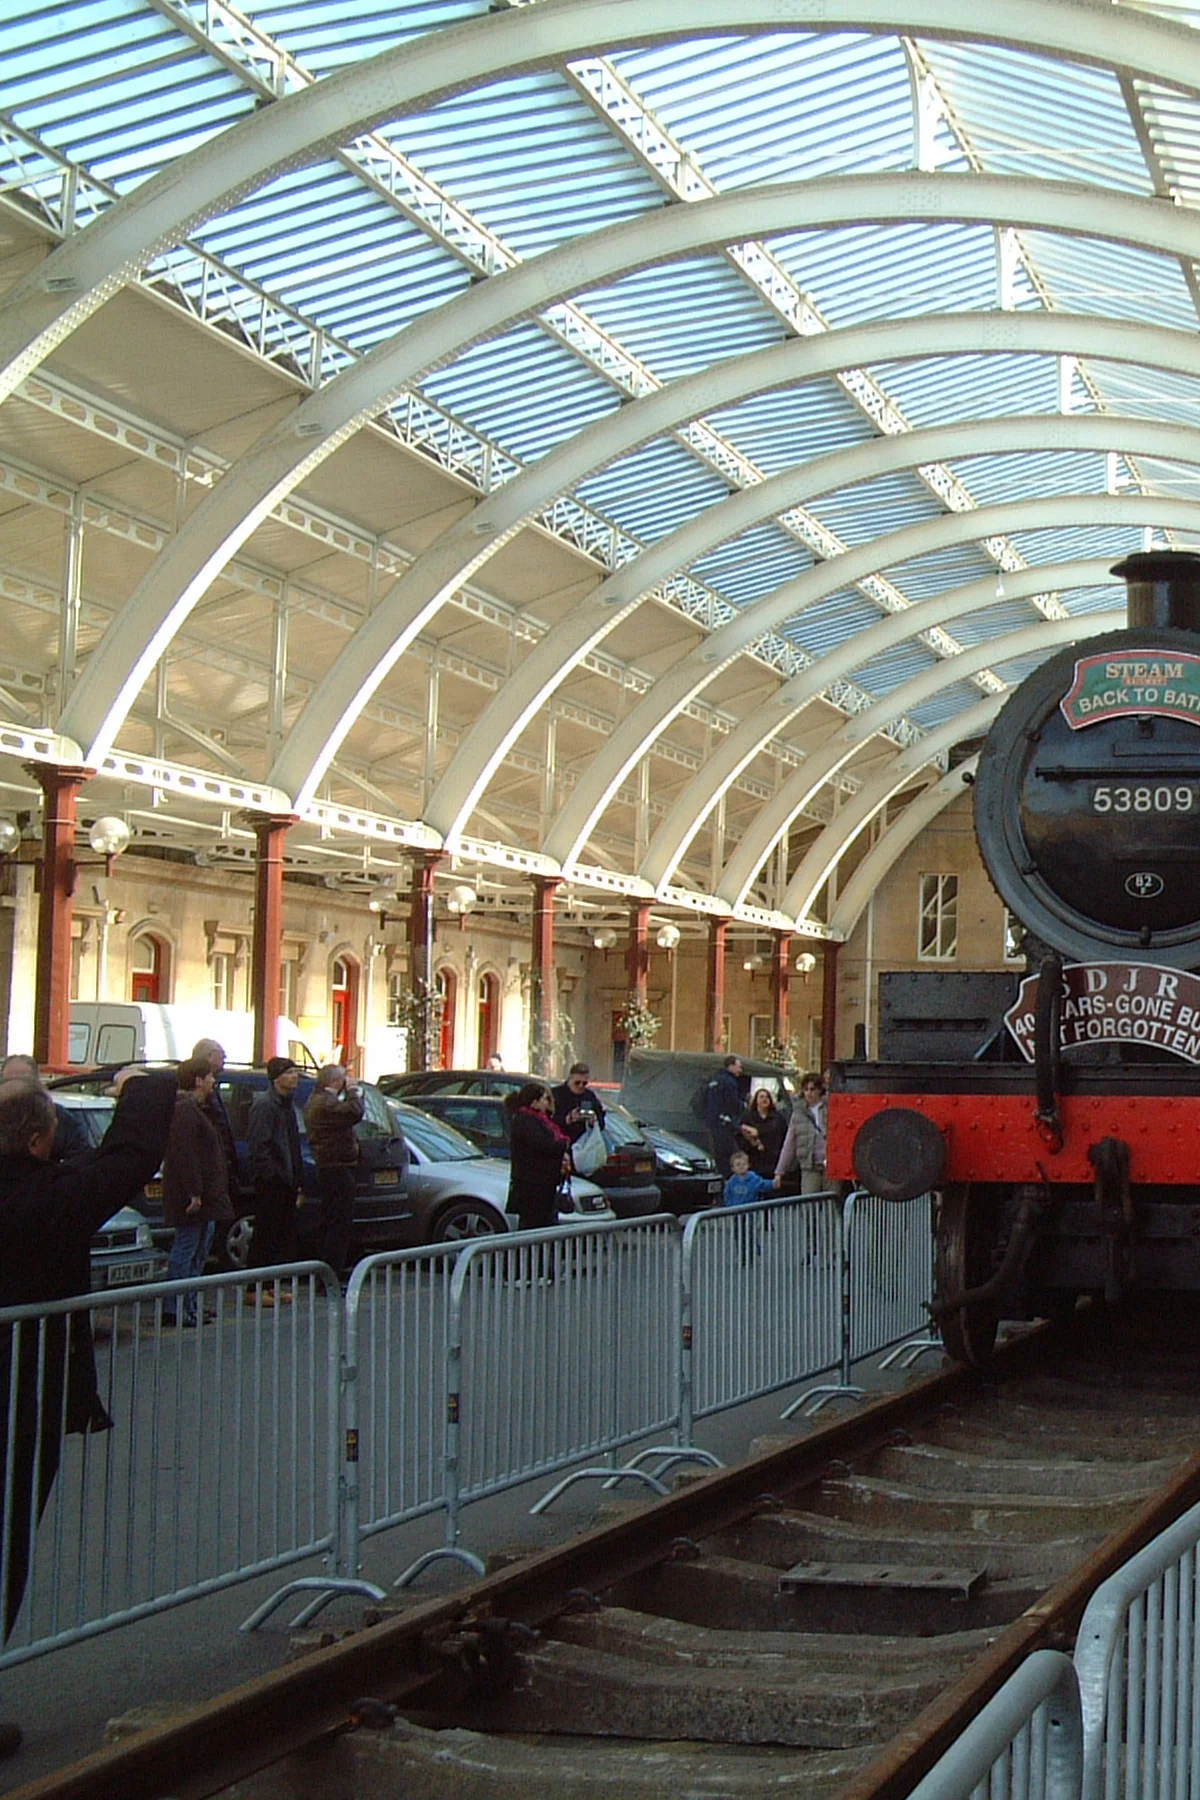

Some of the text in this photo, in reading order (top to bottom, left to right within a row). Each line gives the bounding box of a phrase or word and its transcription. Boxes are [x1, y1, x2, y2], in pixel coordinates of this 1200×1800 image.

[1106, 663, 1184, 679] STEAM
[1079, 689, 1129, 713] BACK
[1134, 688, 1158, 702] TO
[1093, 786, 1193, 812] 53809
[1085, 968, 1108, 992] D
[1123, 968, 1139, 993] J
[1156, 973, 1179, 999] R
[1061, 995, 1174, 1021] ARS-GONE
